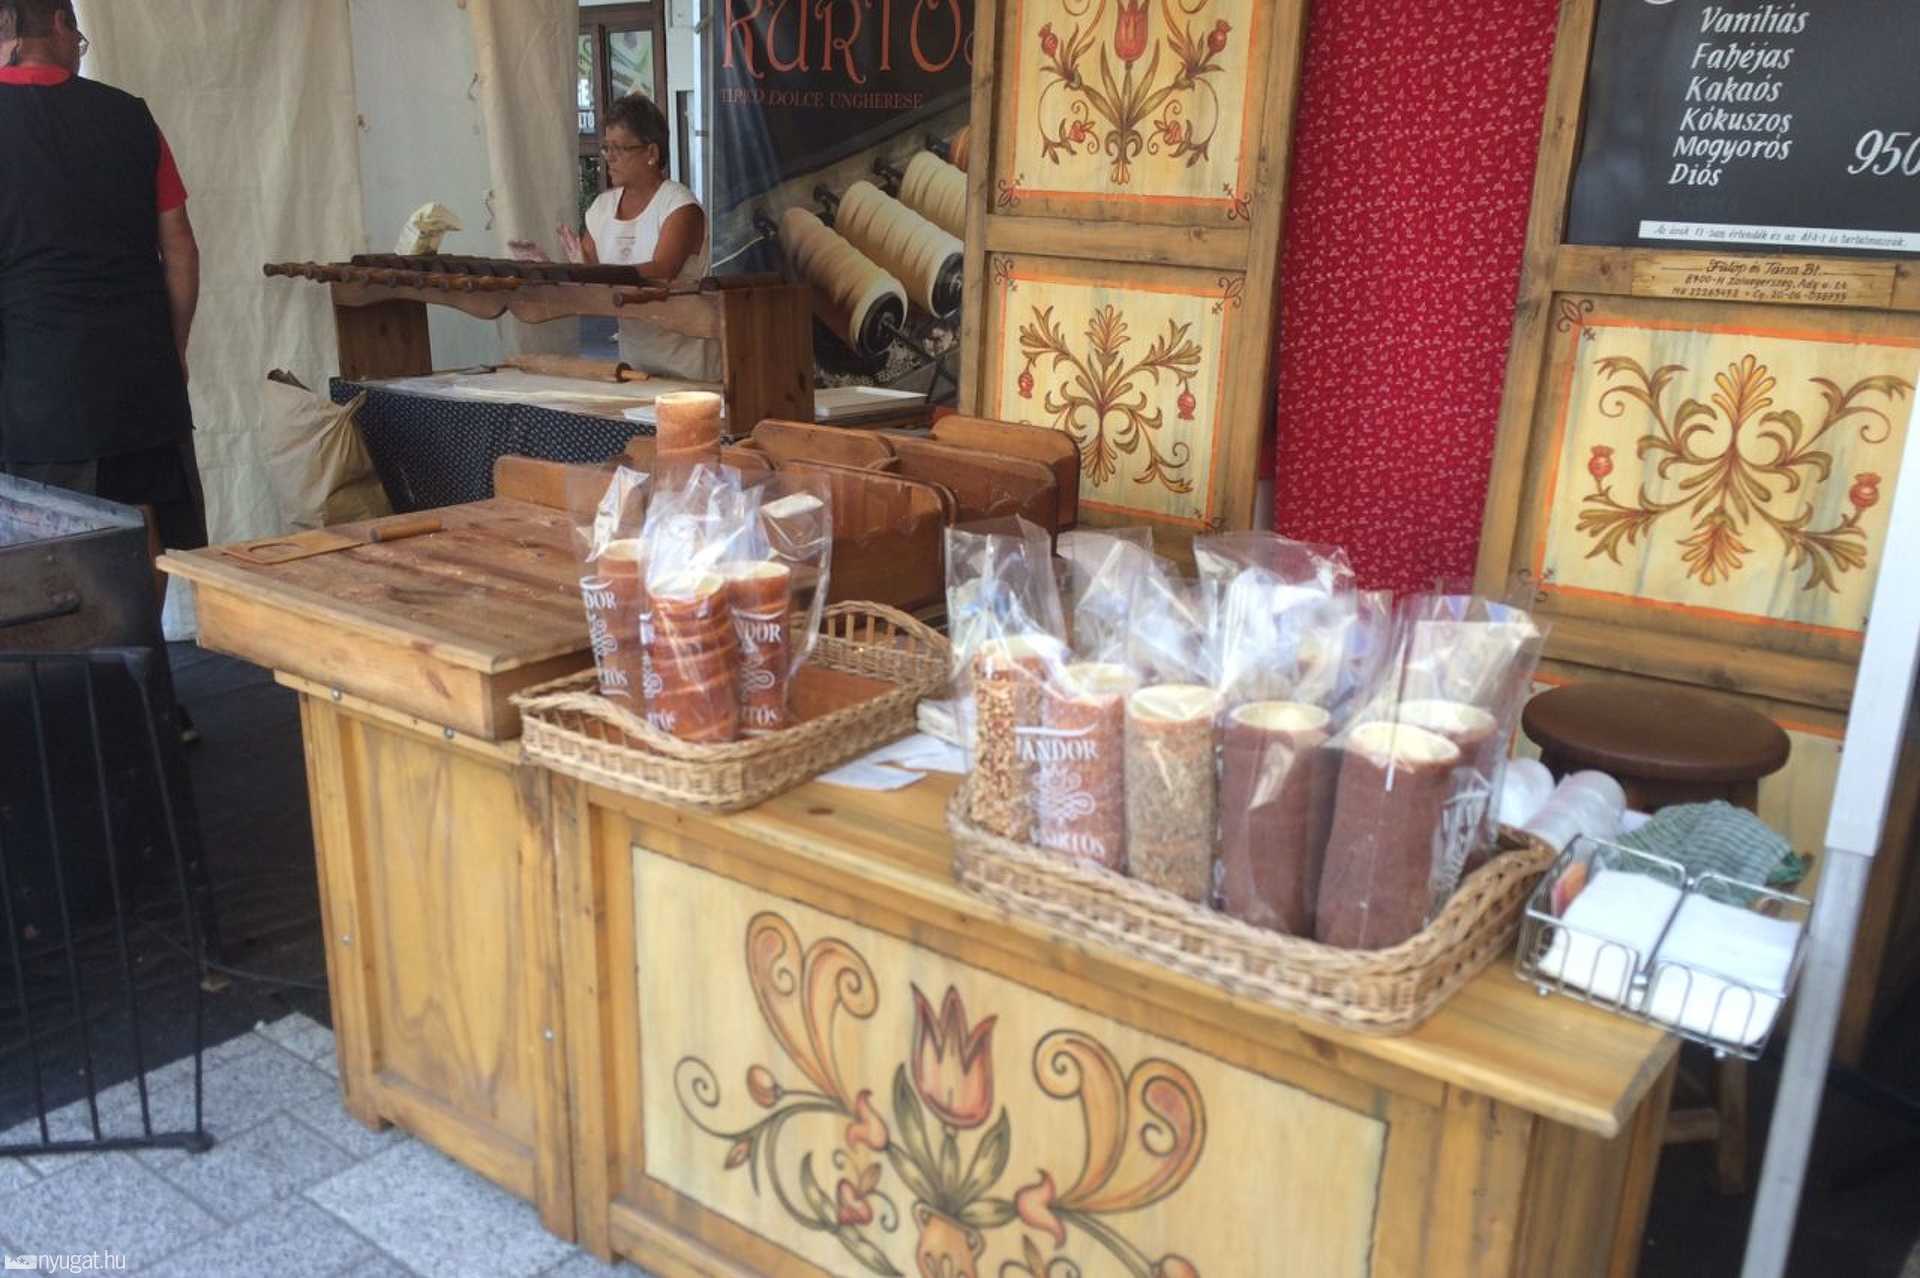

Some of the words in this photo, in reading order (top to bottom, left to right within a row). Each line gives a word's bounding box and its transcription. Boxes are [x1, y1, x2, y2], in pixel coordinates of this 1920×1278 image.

[830, 92, 924, 110] UNGHERESE
[1684, 73, 1783, 103] Kakaós
[1679, 105, 1793, 133] Kókuszos
[1672, 133, 1794, 164] Mogyorós
[1667, 162, 1723, 187] Diós
